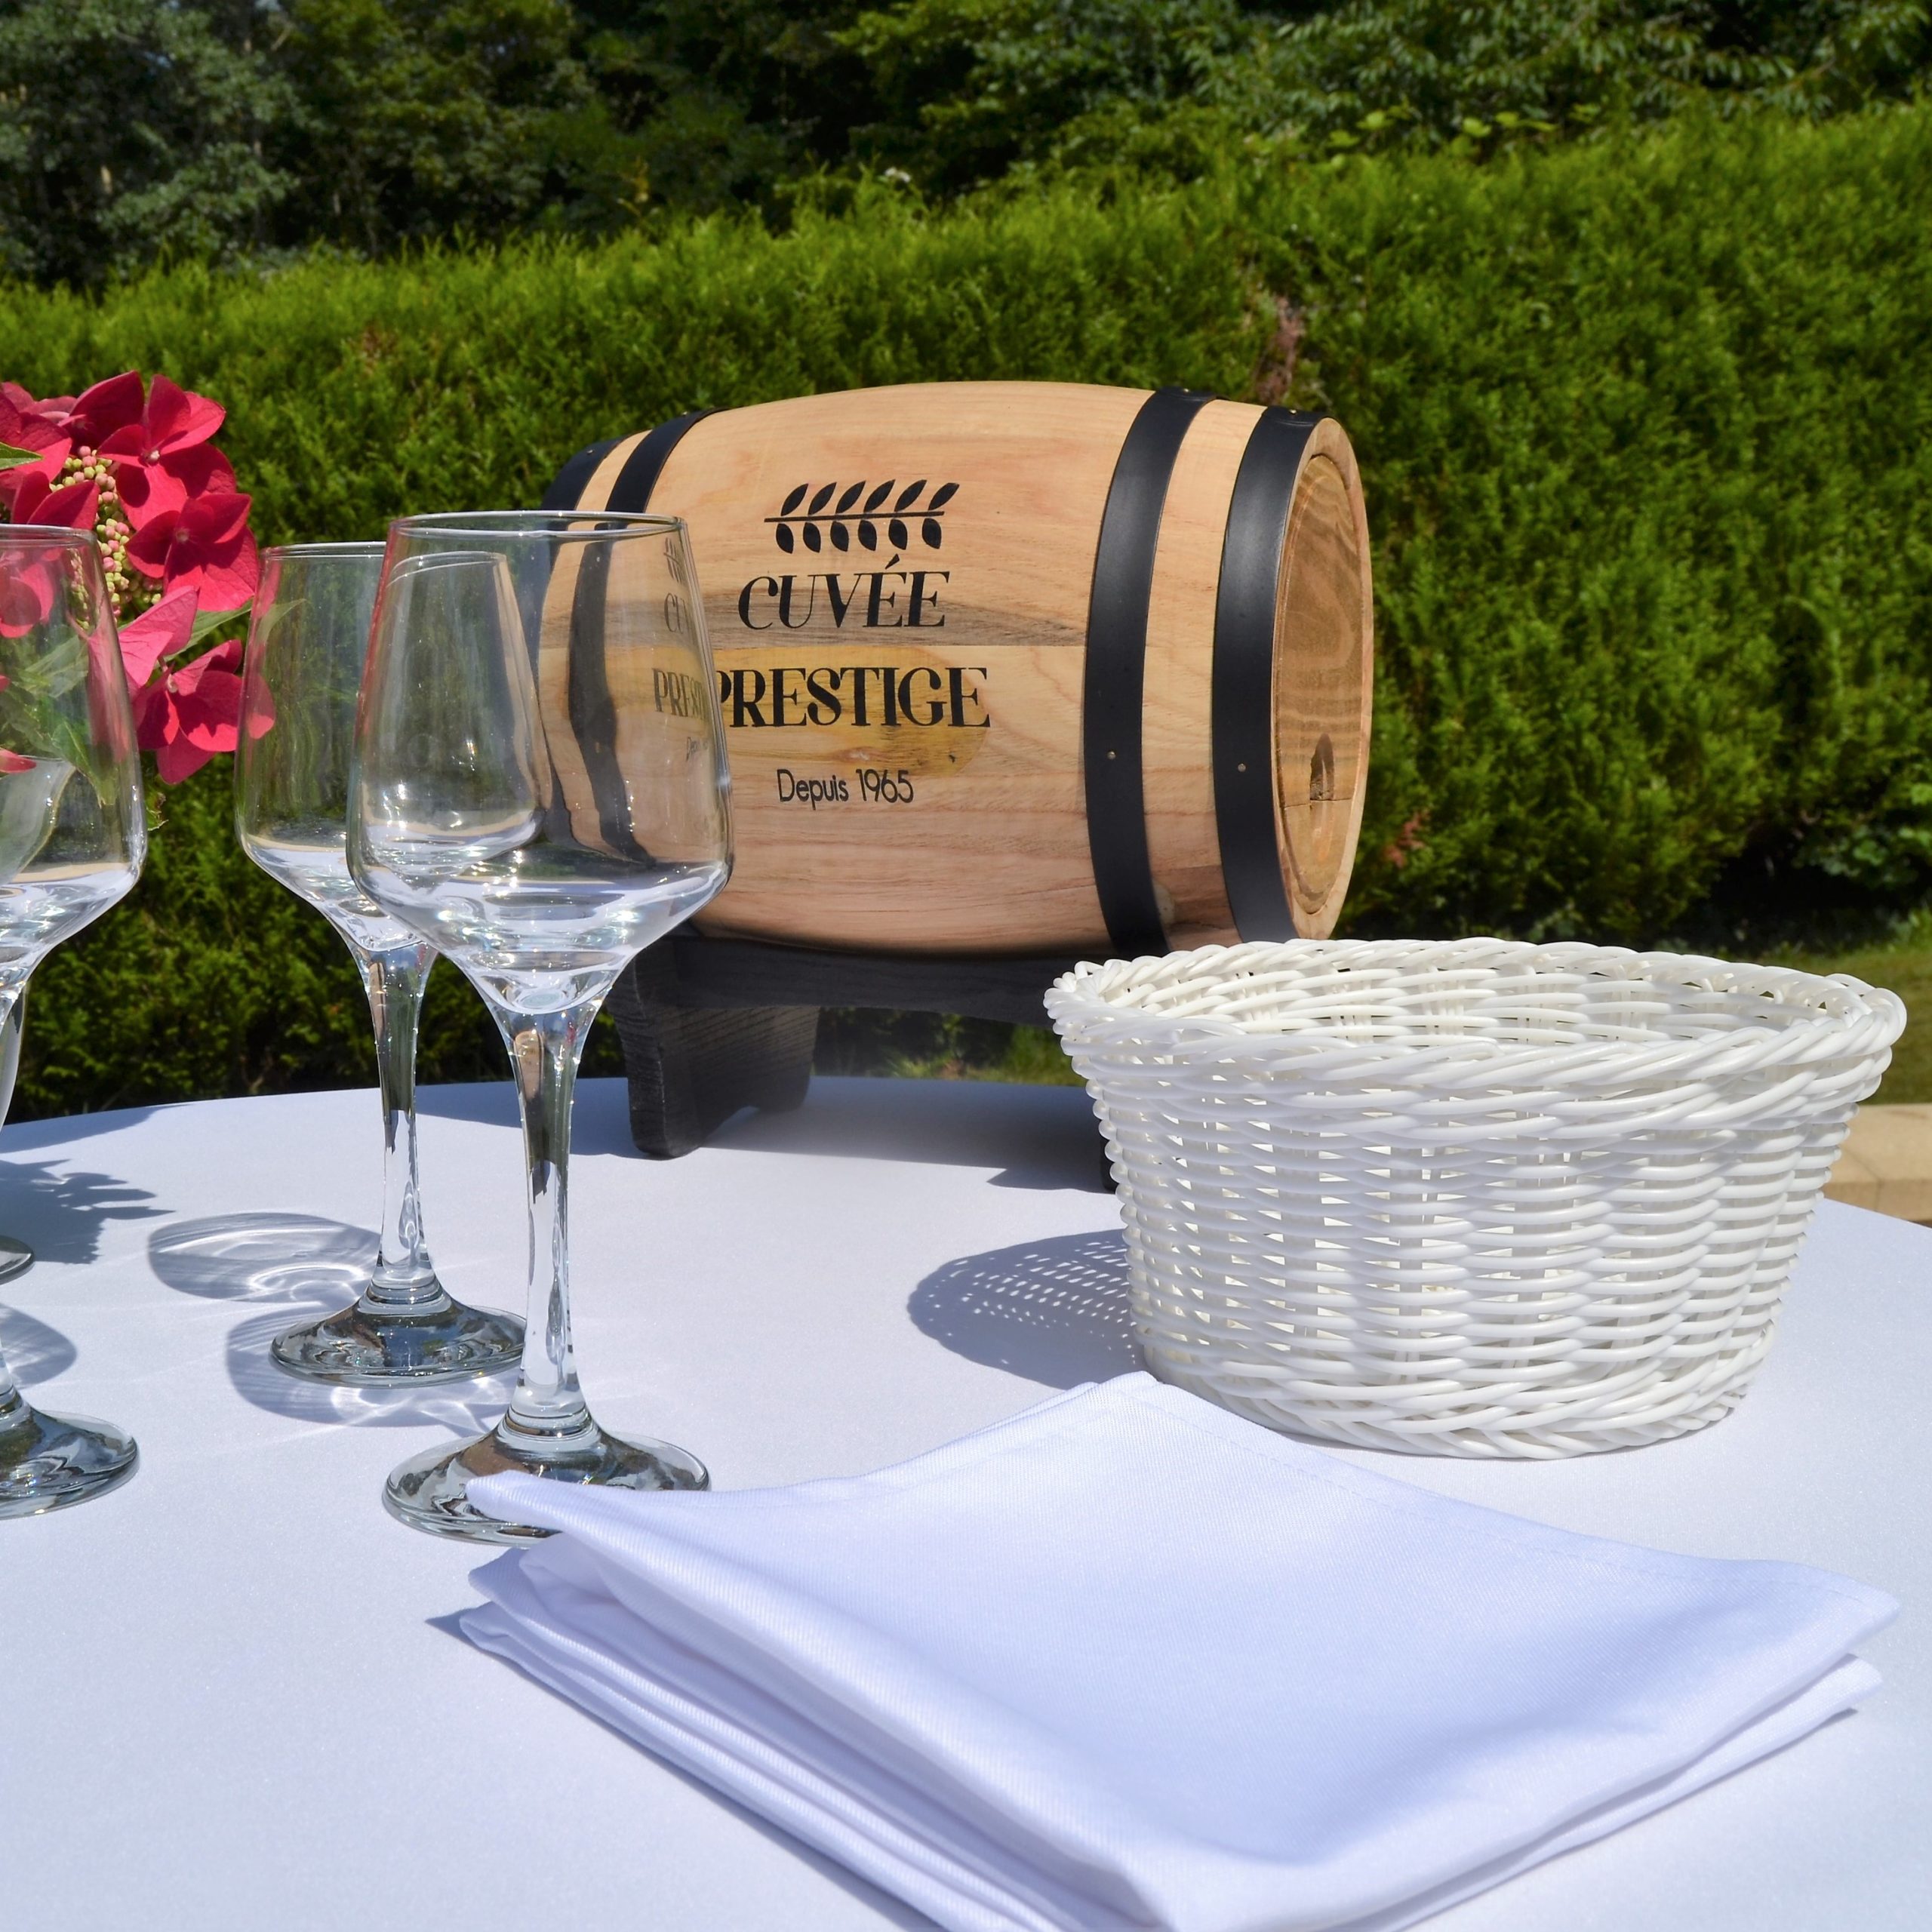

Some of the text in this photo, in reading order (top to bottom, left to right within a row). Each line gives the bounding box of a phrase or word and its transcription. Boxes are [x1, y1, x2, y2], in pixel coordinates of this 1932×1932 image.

[737, 553, 951, 630] CUVÉE
[777, 768, 915, 811] Depuis 1965
